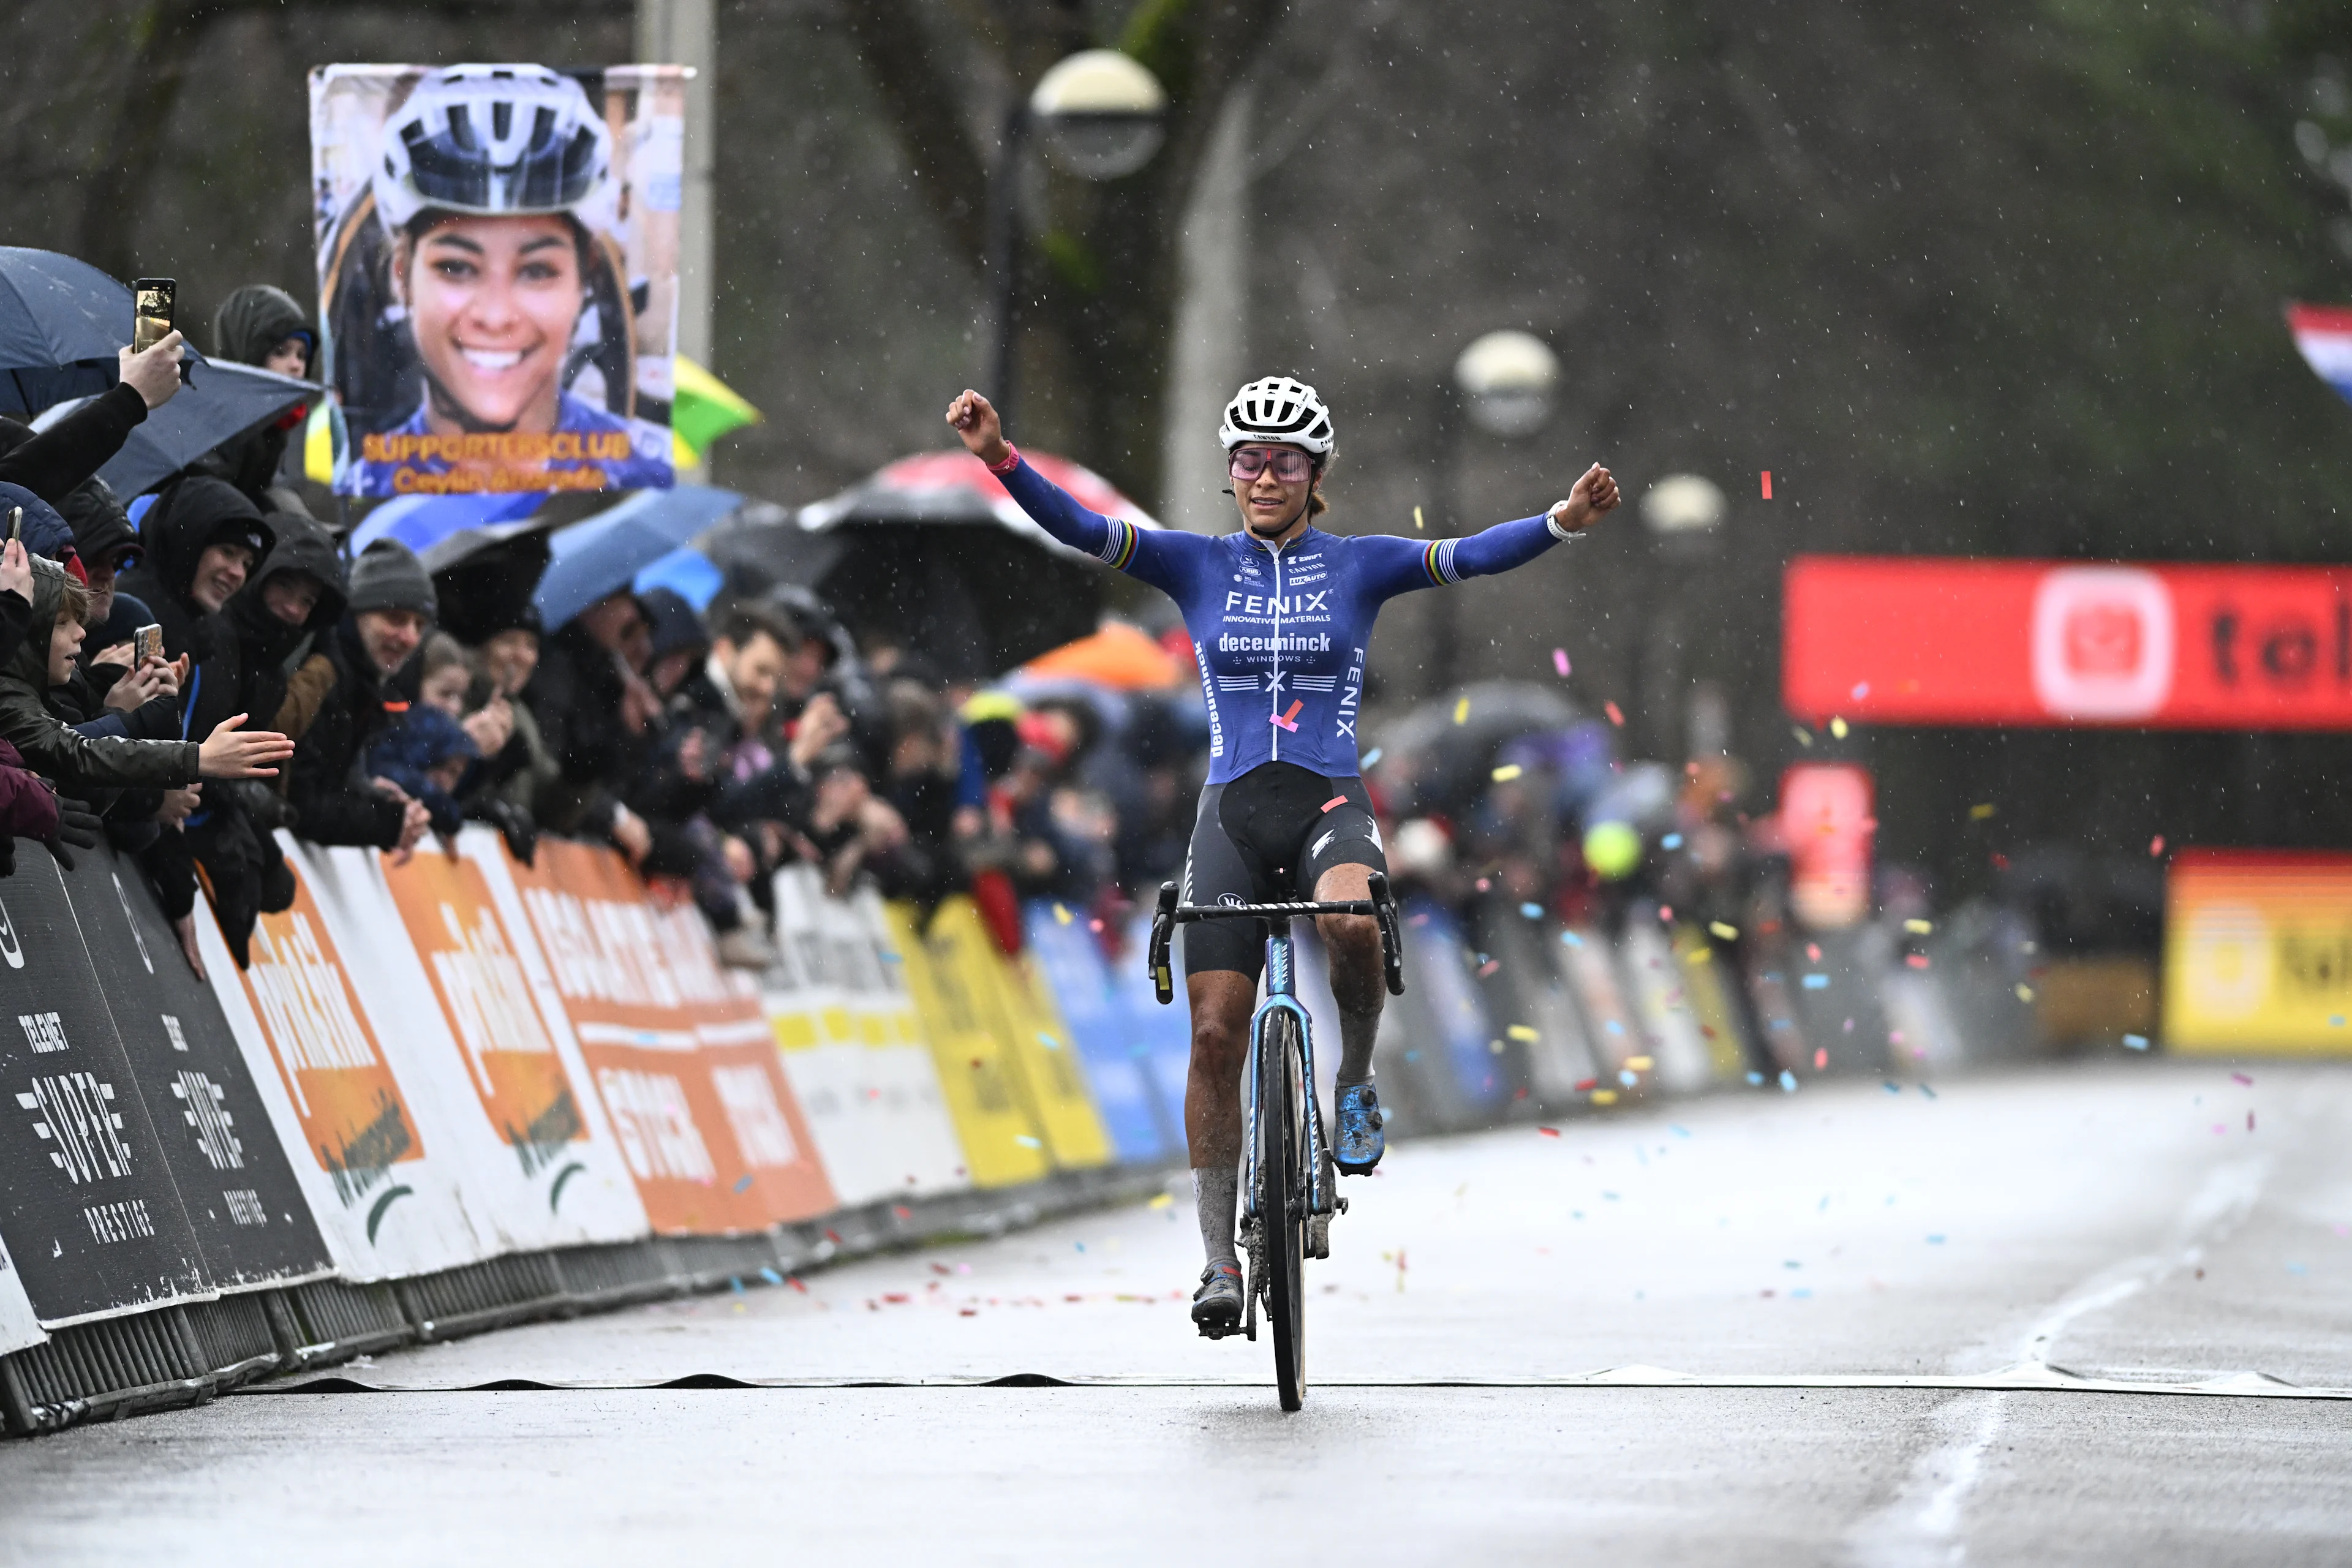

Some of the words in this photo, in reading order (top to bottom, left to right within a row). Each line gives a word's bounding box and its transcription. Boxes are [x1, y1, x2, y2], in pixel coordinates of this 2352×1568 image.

[363, 432, 630, 462] SUPPORTERSCLUB
[1288, 562, 1325, 574] CANYON
[1298, 553, 1323, 562] ZWIFT
[1223, 615, 1276, 625] INNOVATIVE
[1280, 614, 1331, 624] MATERIALS
[1219, 632, 1331, 652] deceuninck
[1246, 655, 1301, 663] WINDOWS
[1194, 640, 1224, 758] deceuninck
[1336, 647, 1364, 739] FENIX
[18, 1011, 69, 1053] TELENET
[32, 1071, 132, 1185] SUPER
[83, 1199, 154, 1245] PRESTIGE
